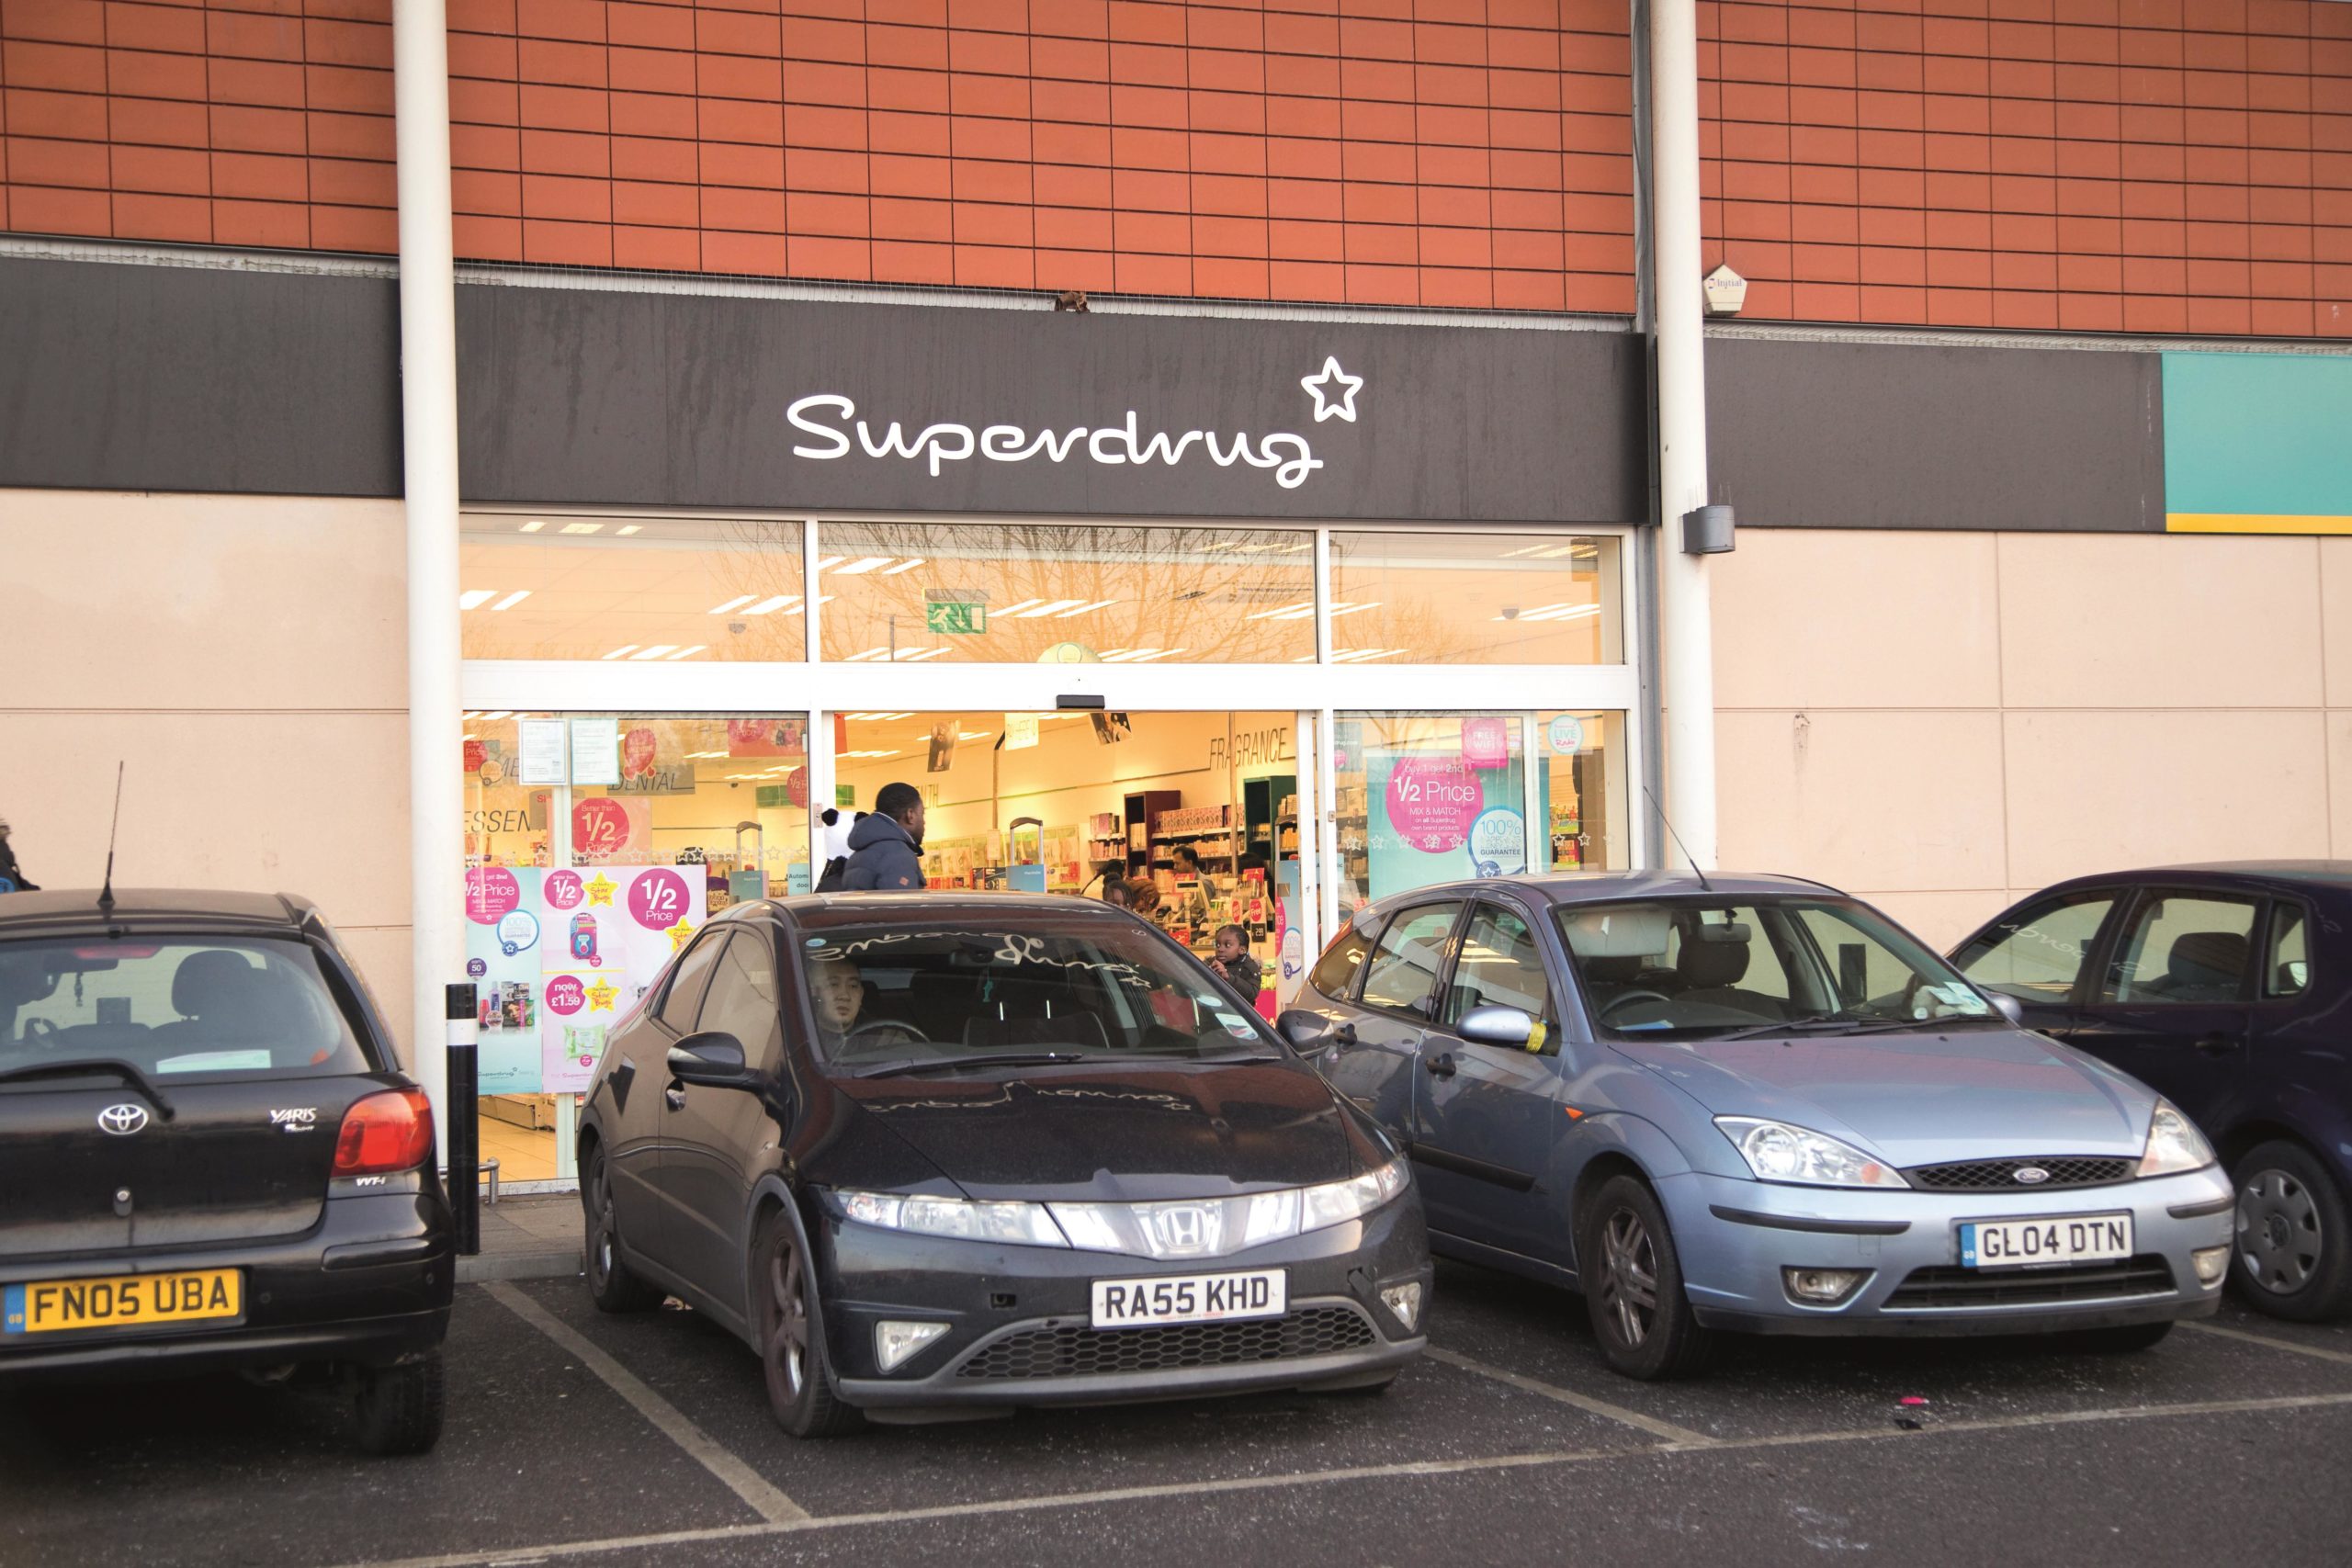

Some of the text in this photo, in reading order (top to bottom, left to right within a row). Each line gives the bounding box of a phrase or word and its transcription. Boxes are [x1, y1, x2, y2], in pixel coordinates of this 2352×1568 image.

[786, 394, 1325, 489] Superdrug
[1209, 727, 1289, 770] FRAGRANCE
[1394, 776, 1476, 802] 1/2 Price
[1409, 807, 1461, 816] MIX & MATCH
[582, 812, 616, 841] 1/2
[1481, 819, 1521, 835] 100%
[484, 884, 515, 897] Price
[553, 879, 576, 899] 1/2
[641, 878, 677, 910] 1/2
[645, 910, 673, 921] Price
[551, 993, 581, 1007] £1.59
[554, 984, 578, 992] now
[1983, 1221, 2125, 1258] GL04 DTN
[34, 1275, 230, 1324] FN05 UBA
[1105, 1276, 1270, 1319] RA55 KHD
